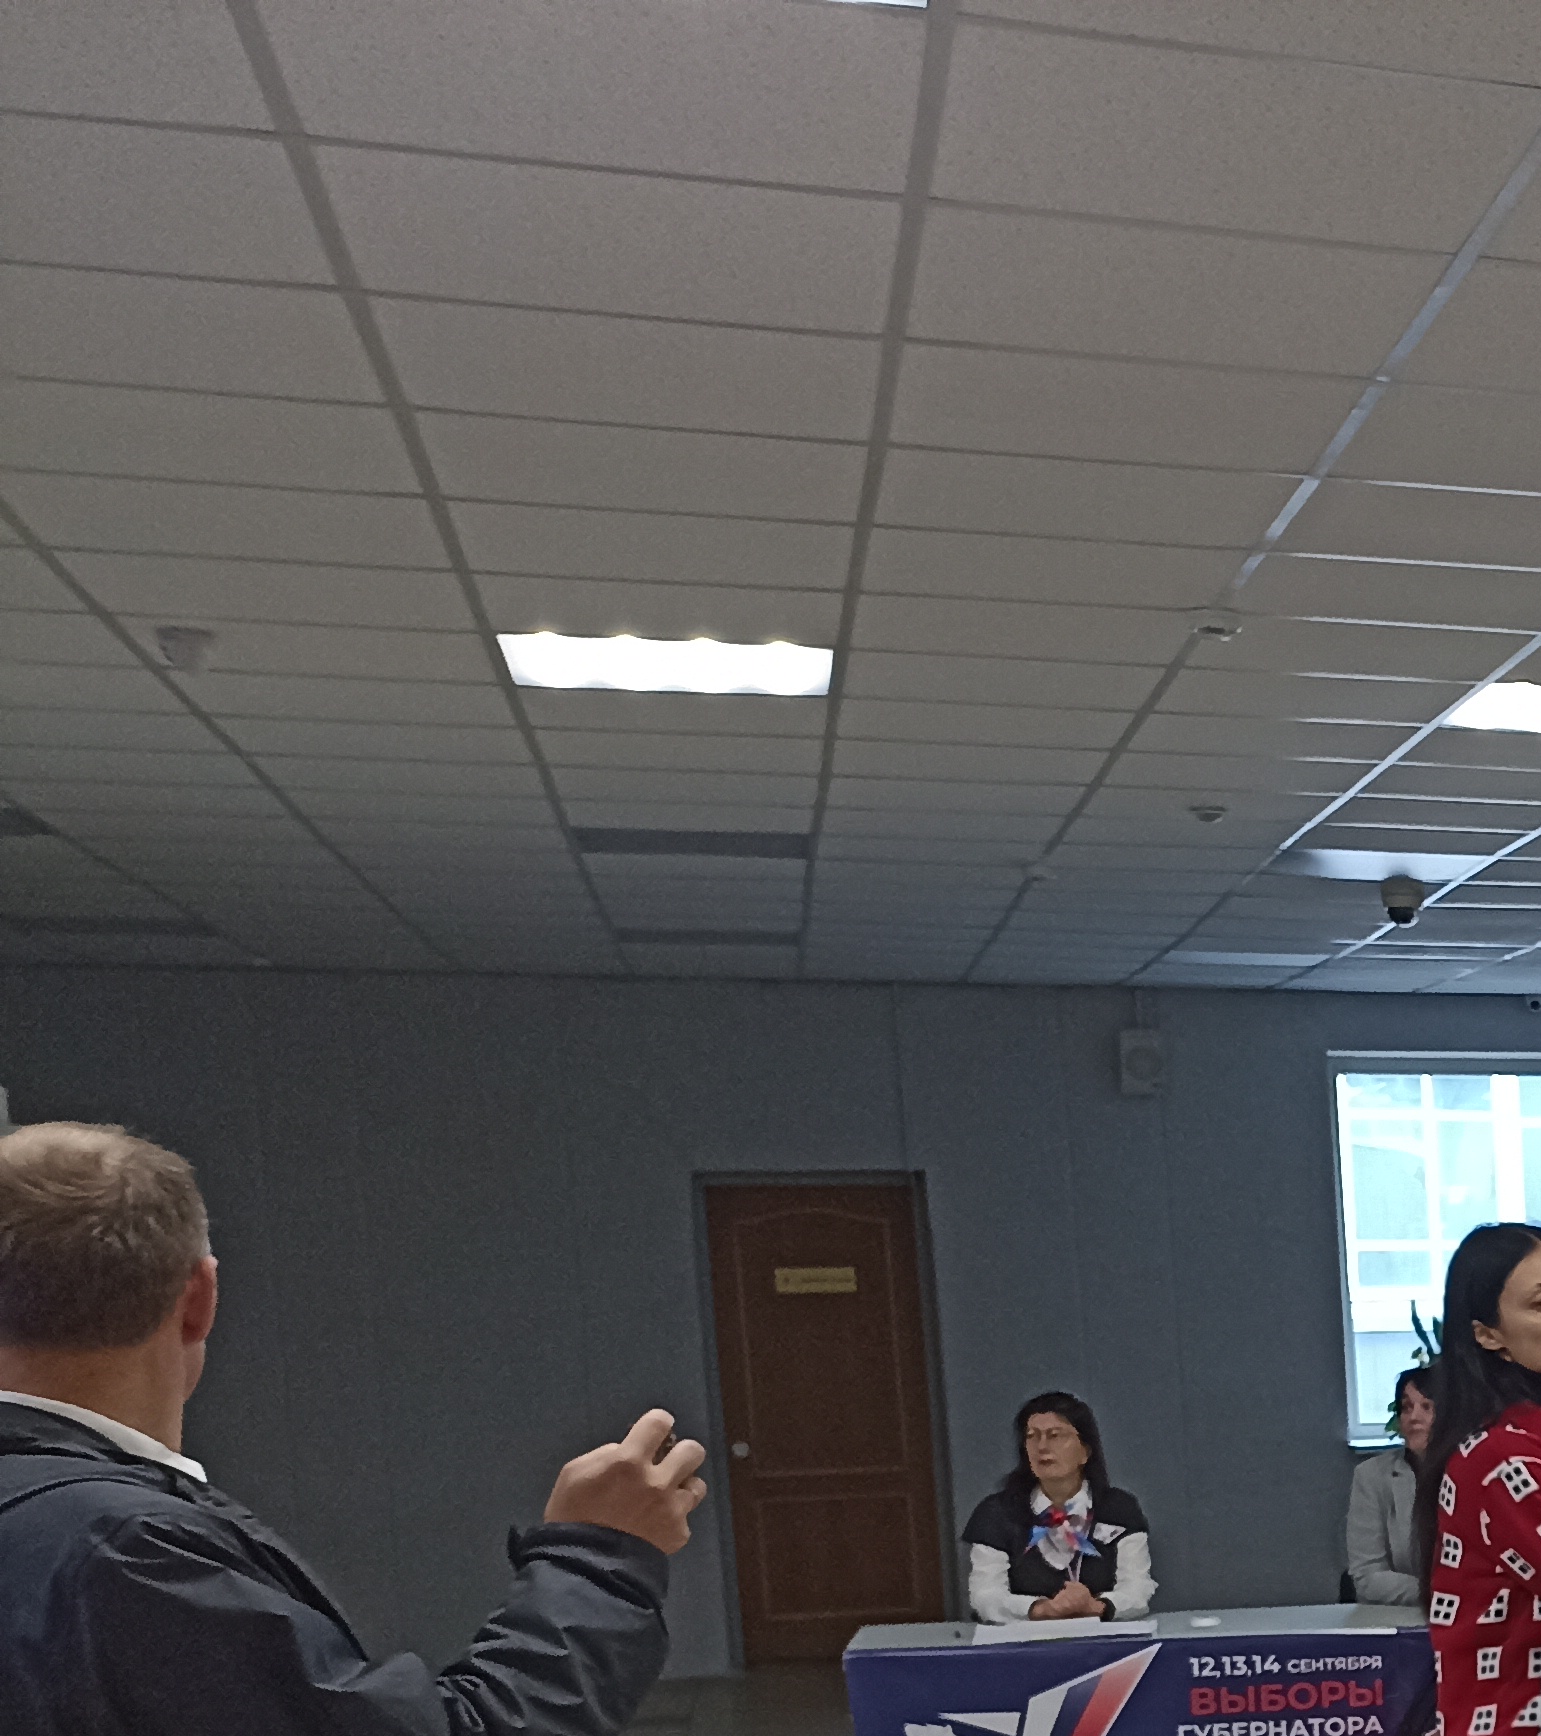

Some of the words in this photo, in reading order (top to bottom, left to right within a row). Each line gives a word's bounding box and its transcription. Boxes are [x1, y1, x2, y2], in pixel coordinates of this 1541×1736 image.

[1189, 1655, 1282, 1679] 12,13,14
[1287, 1655, 1383, 1674] СЕНТЯБРЯ
[1189, 1678, 1384, 1716] ВЫБОРЫ
